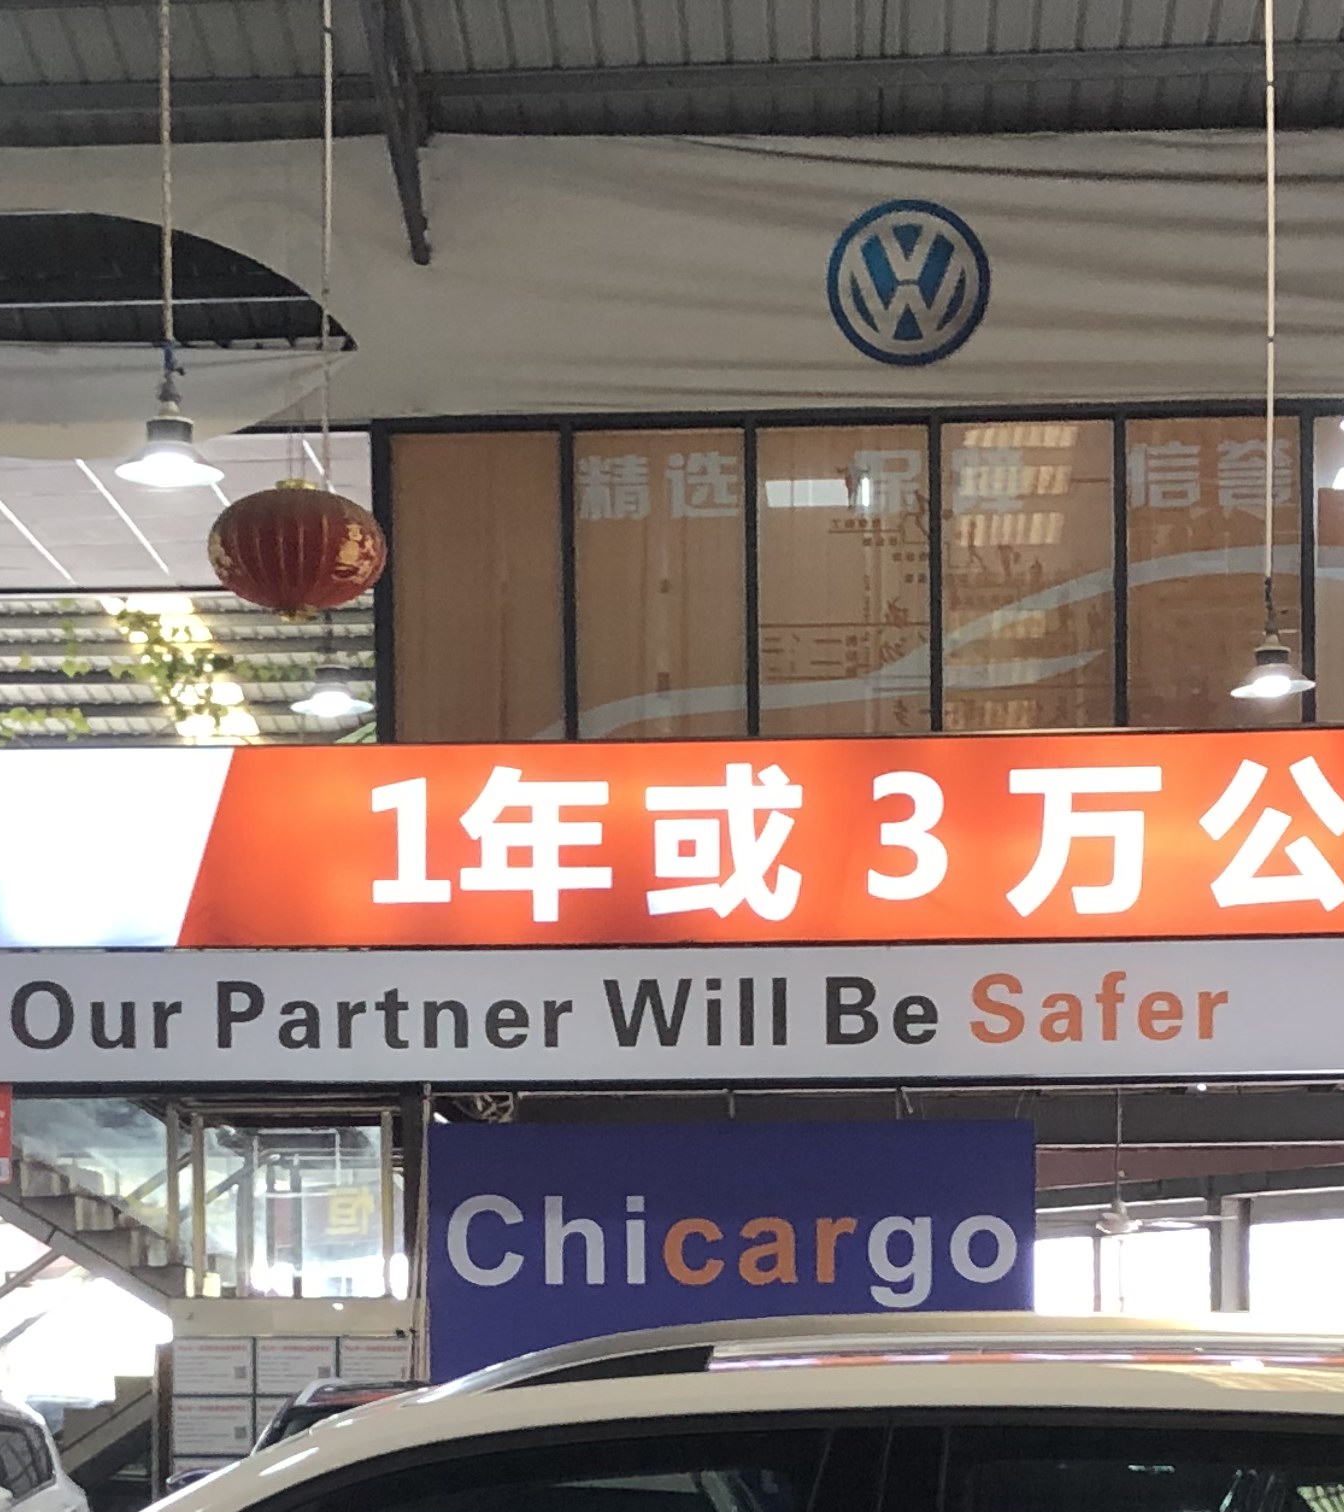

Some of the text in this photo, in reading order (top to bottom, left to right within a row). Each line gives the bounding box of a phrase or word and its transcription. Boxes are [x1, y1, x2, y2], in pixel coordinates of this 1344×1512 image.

[578, 450, 742, 522] 精选
[10, 980, 182, 1050] Our
[217, 980, 573, 1050] Partner
[603, 977, 787, 1047] Will
[825, 976, 939, 1046] Be
[969, 970, 1230, 1045] Safer
[446, 1193, 1017, 1309] Chicargo
